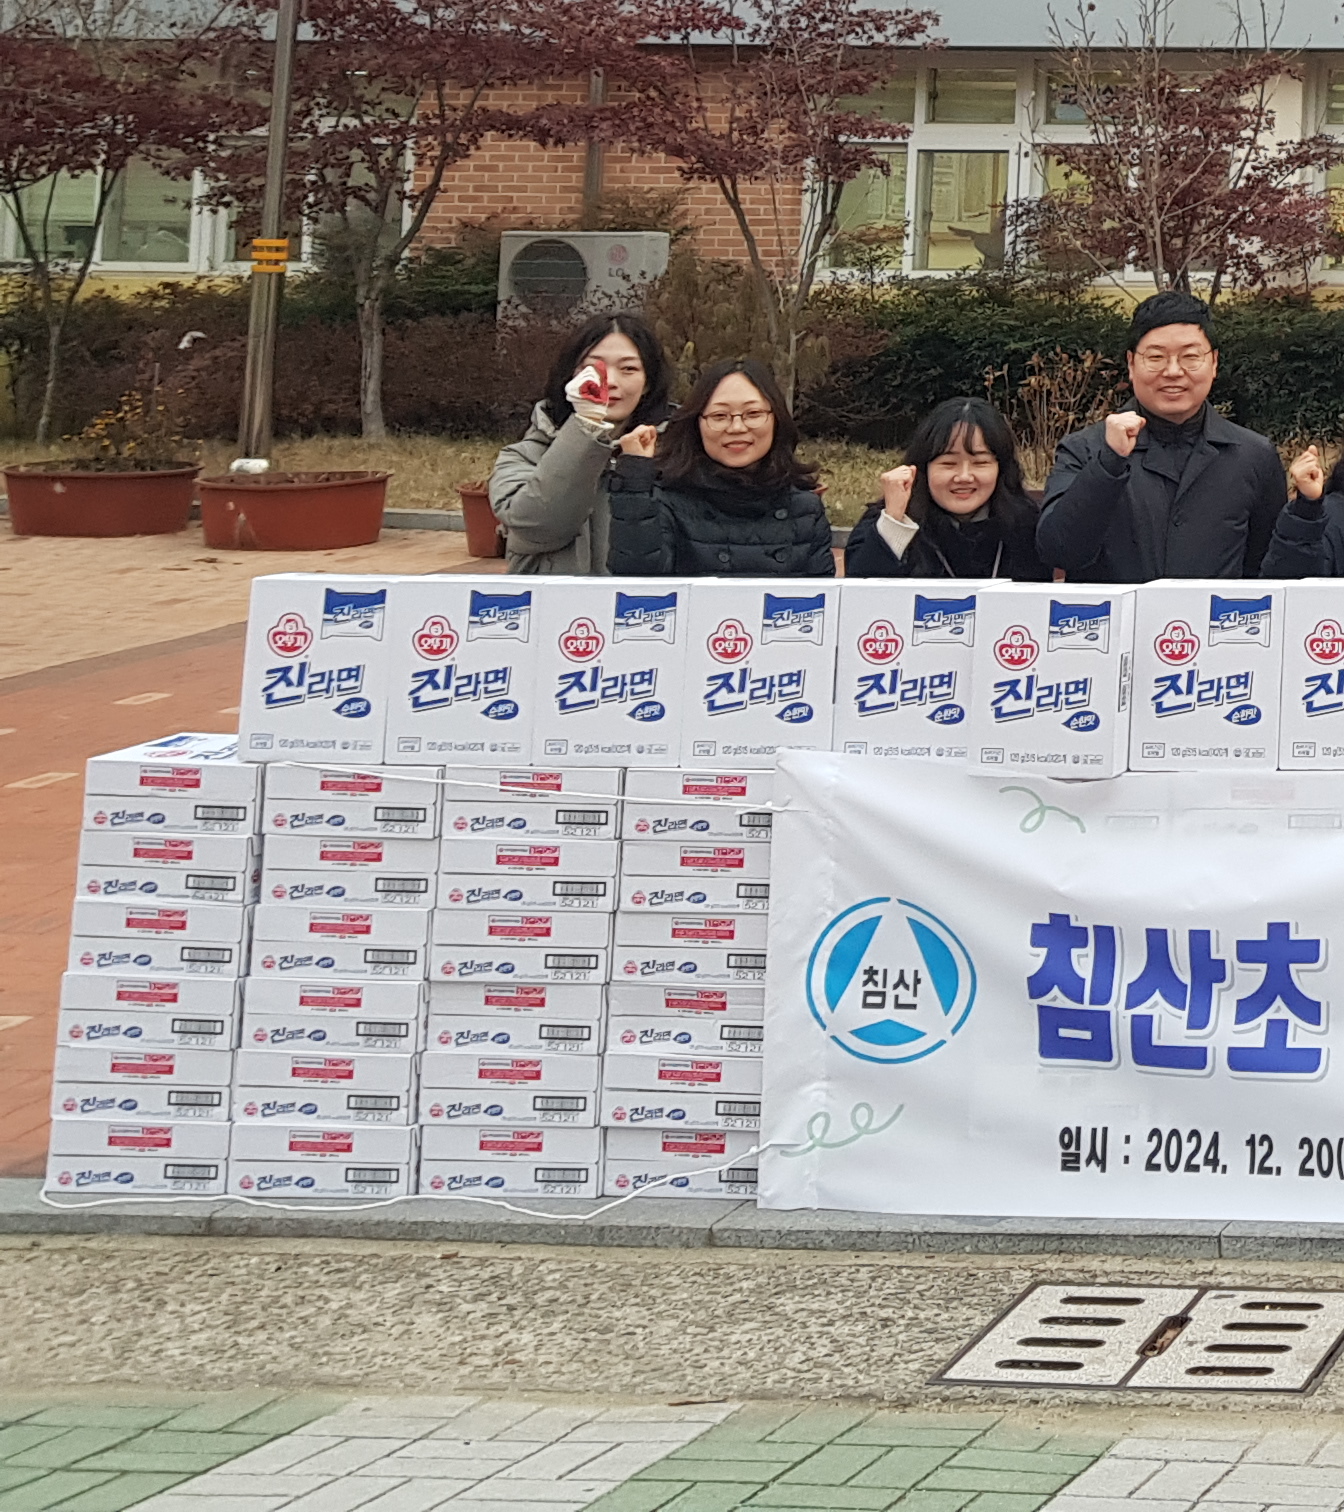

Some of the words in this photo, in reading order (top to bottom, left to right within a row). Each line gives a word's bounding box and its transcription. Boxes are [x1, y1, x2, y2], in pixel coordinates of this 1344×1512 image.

[275, 634, 305, 648] 오뚜기
[420, 637, 451, 651] 오뚜기
[566, 639, 597, 653] 오뚜기
[714, 640, 745, 654] 오뚜기
[865, 641, 896, 655] 오뚜기
[1001, 646, 1031, 661] 오뚜기
[1162, 641, 1192, 656] 오뚜기
[1312, 640, 1343, 655] 오뚜기
[262, 661, 364, 709] 진라면
[409, 664, 511, 712] 진라면
[555, 666, 657, 714] 진라면
[705, 667, 805, 715] 진라면
[855, 668, 957, 716] 진라면
[990, 674, 1092, 724] 진라면
[1151, 669, 1253, 717] 진라면
[862, 965, 921, 1010] 침산
[1028, 912, 1324, 1074] 침산초
[1059, 1126, 1108, 1173] 일시
[1145, 1127, 1227, 1175] 2024.
[1245, 1133, 1282, 1176] 12.
